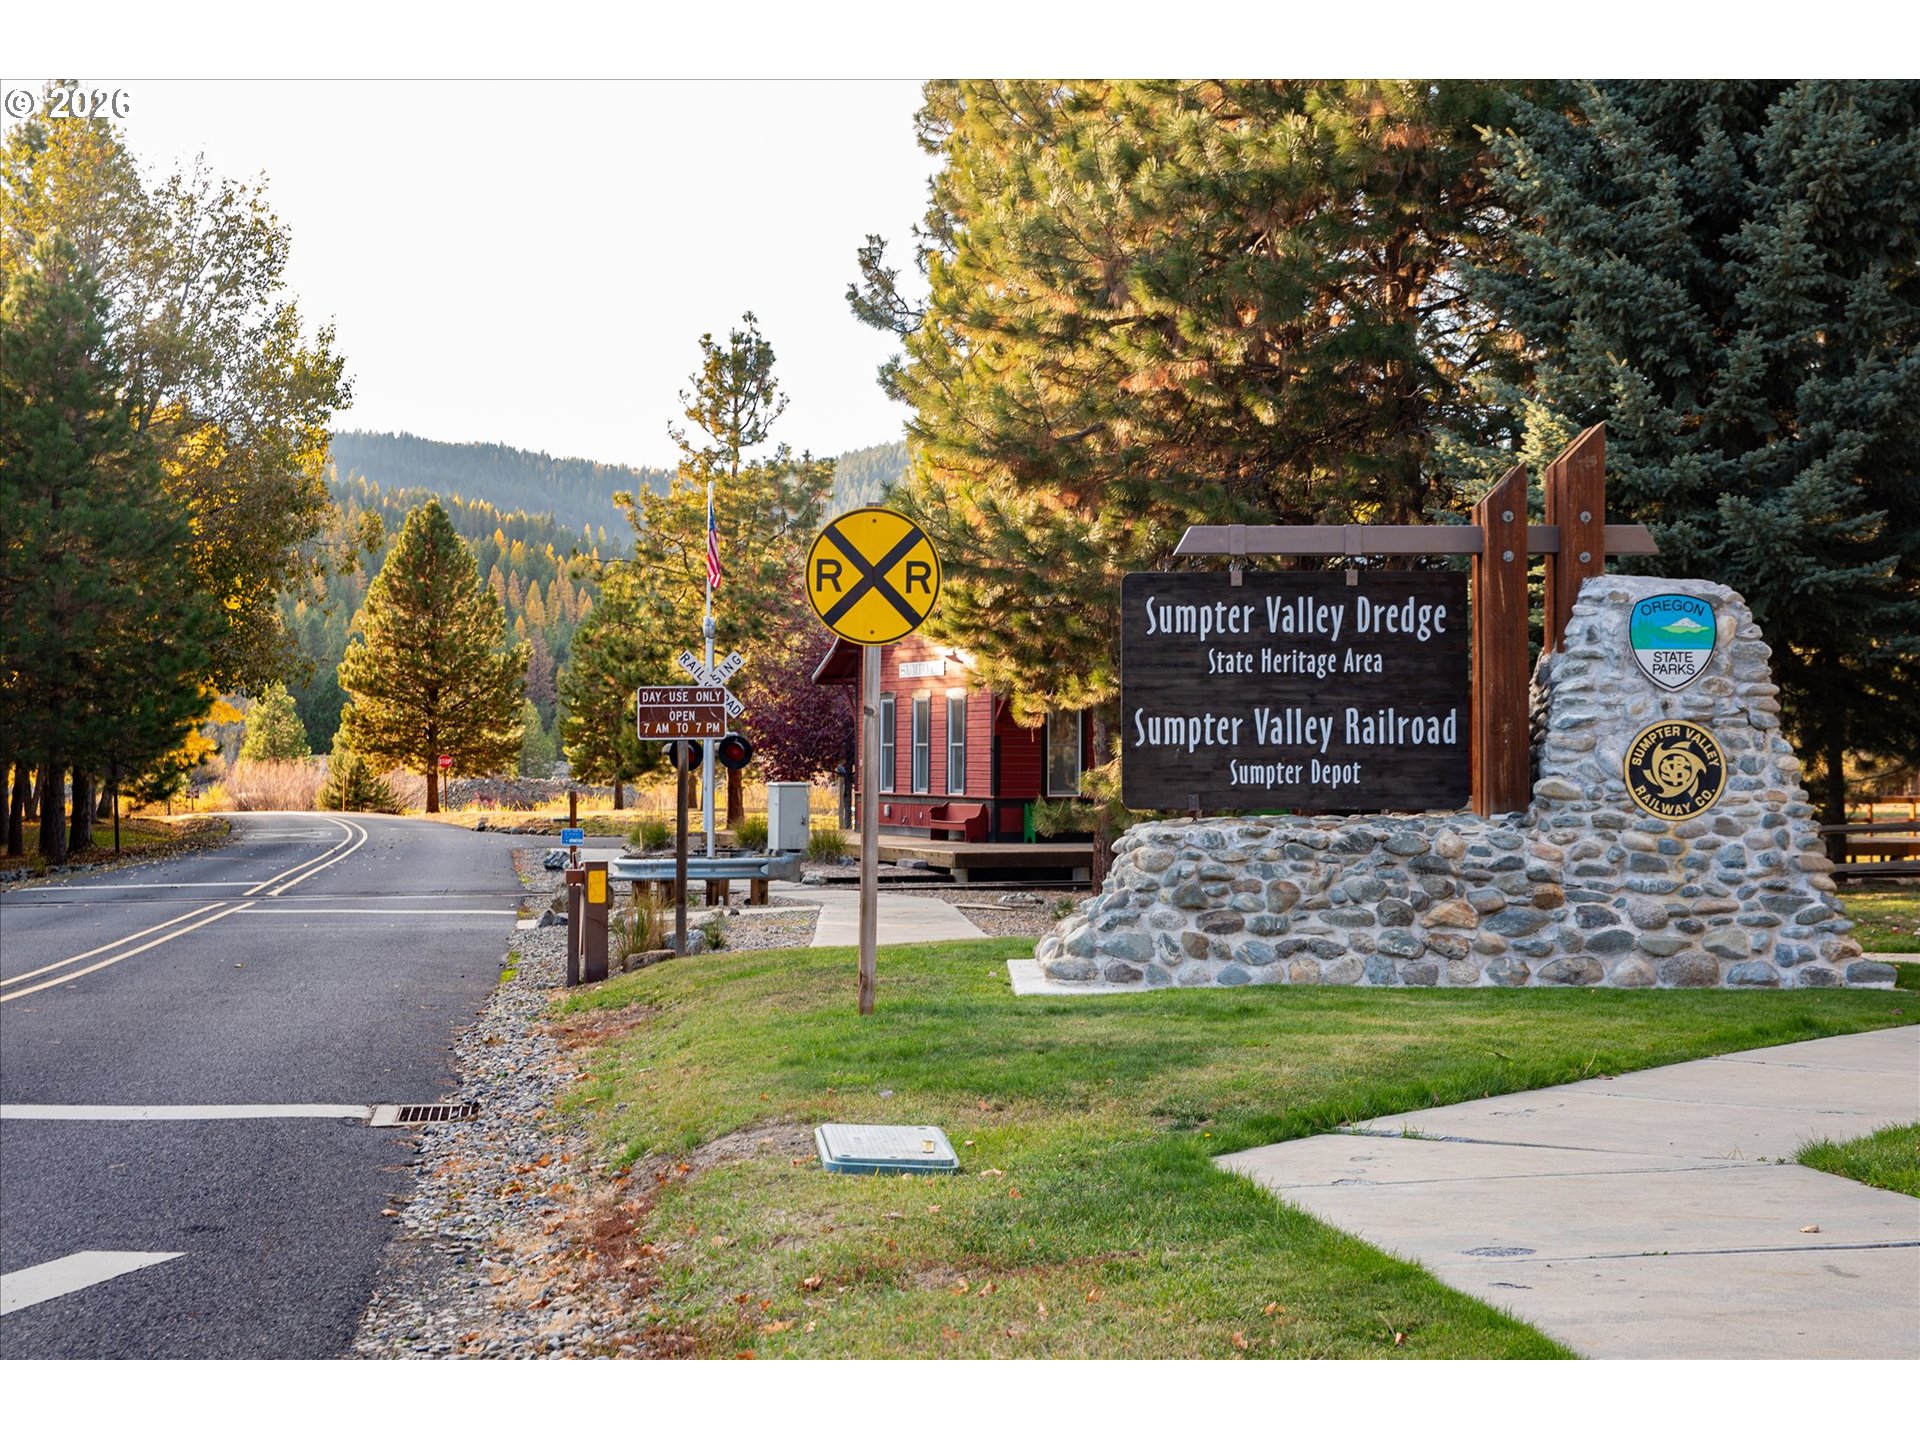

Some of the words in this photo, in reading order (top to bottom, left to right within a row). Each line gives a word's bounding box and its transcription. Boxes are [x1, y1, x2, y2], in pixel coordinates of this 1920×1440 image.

[816, 558, 843, 593] R
[905, 560, 932, 594] R
[1146, 596, 1255, 642] Sumpter
[1266, 596, 1345, 642] Valley
[1357, 596, 1447, 642] Dredge
[1640, 599, 1706, 617] OREGON
[1208, 648, 1254, 675] State
[1261, 648, 1336, 679] Heritage
[1343, 648, 1383, 673] Area
[1652, 663, 1696, 676] PARKS
[1653, 651, 1694, 663] STATE
[642, 691, 662, 702] DAY
[669, 691, 689, 702] USE
[696, 691, 721, 702] ONLY
[643, 723, 650, 734] 7
[655, 723, 669, 733] AM
[676, 723, 689, 733] TO
[696, 723, 702, 733] 7
[706, 722, 720, 733] PM
[669, 710, 696, 721] OPEN
[1135, 707, 1244, 753] Sumpter
[1254, 707, 1334, 753] Valley
[1346, 707, 1457, 745] Railroad
[1631, 726, 1681, 766] SUMPTER
[1685, 728, 1720, 767] VALLEY
[1230, 759, 1303, 790] Sumpter
[1311, 759, 1361, 788] Depot
[1635, 784, 1691, 814] RAILWAY
[1694, 788, 1716, 807] CO.
